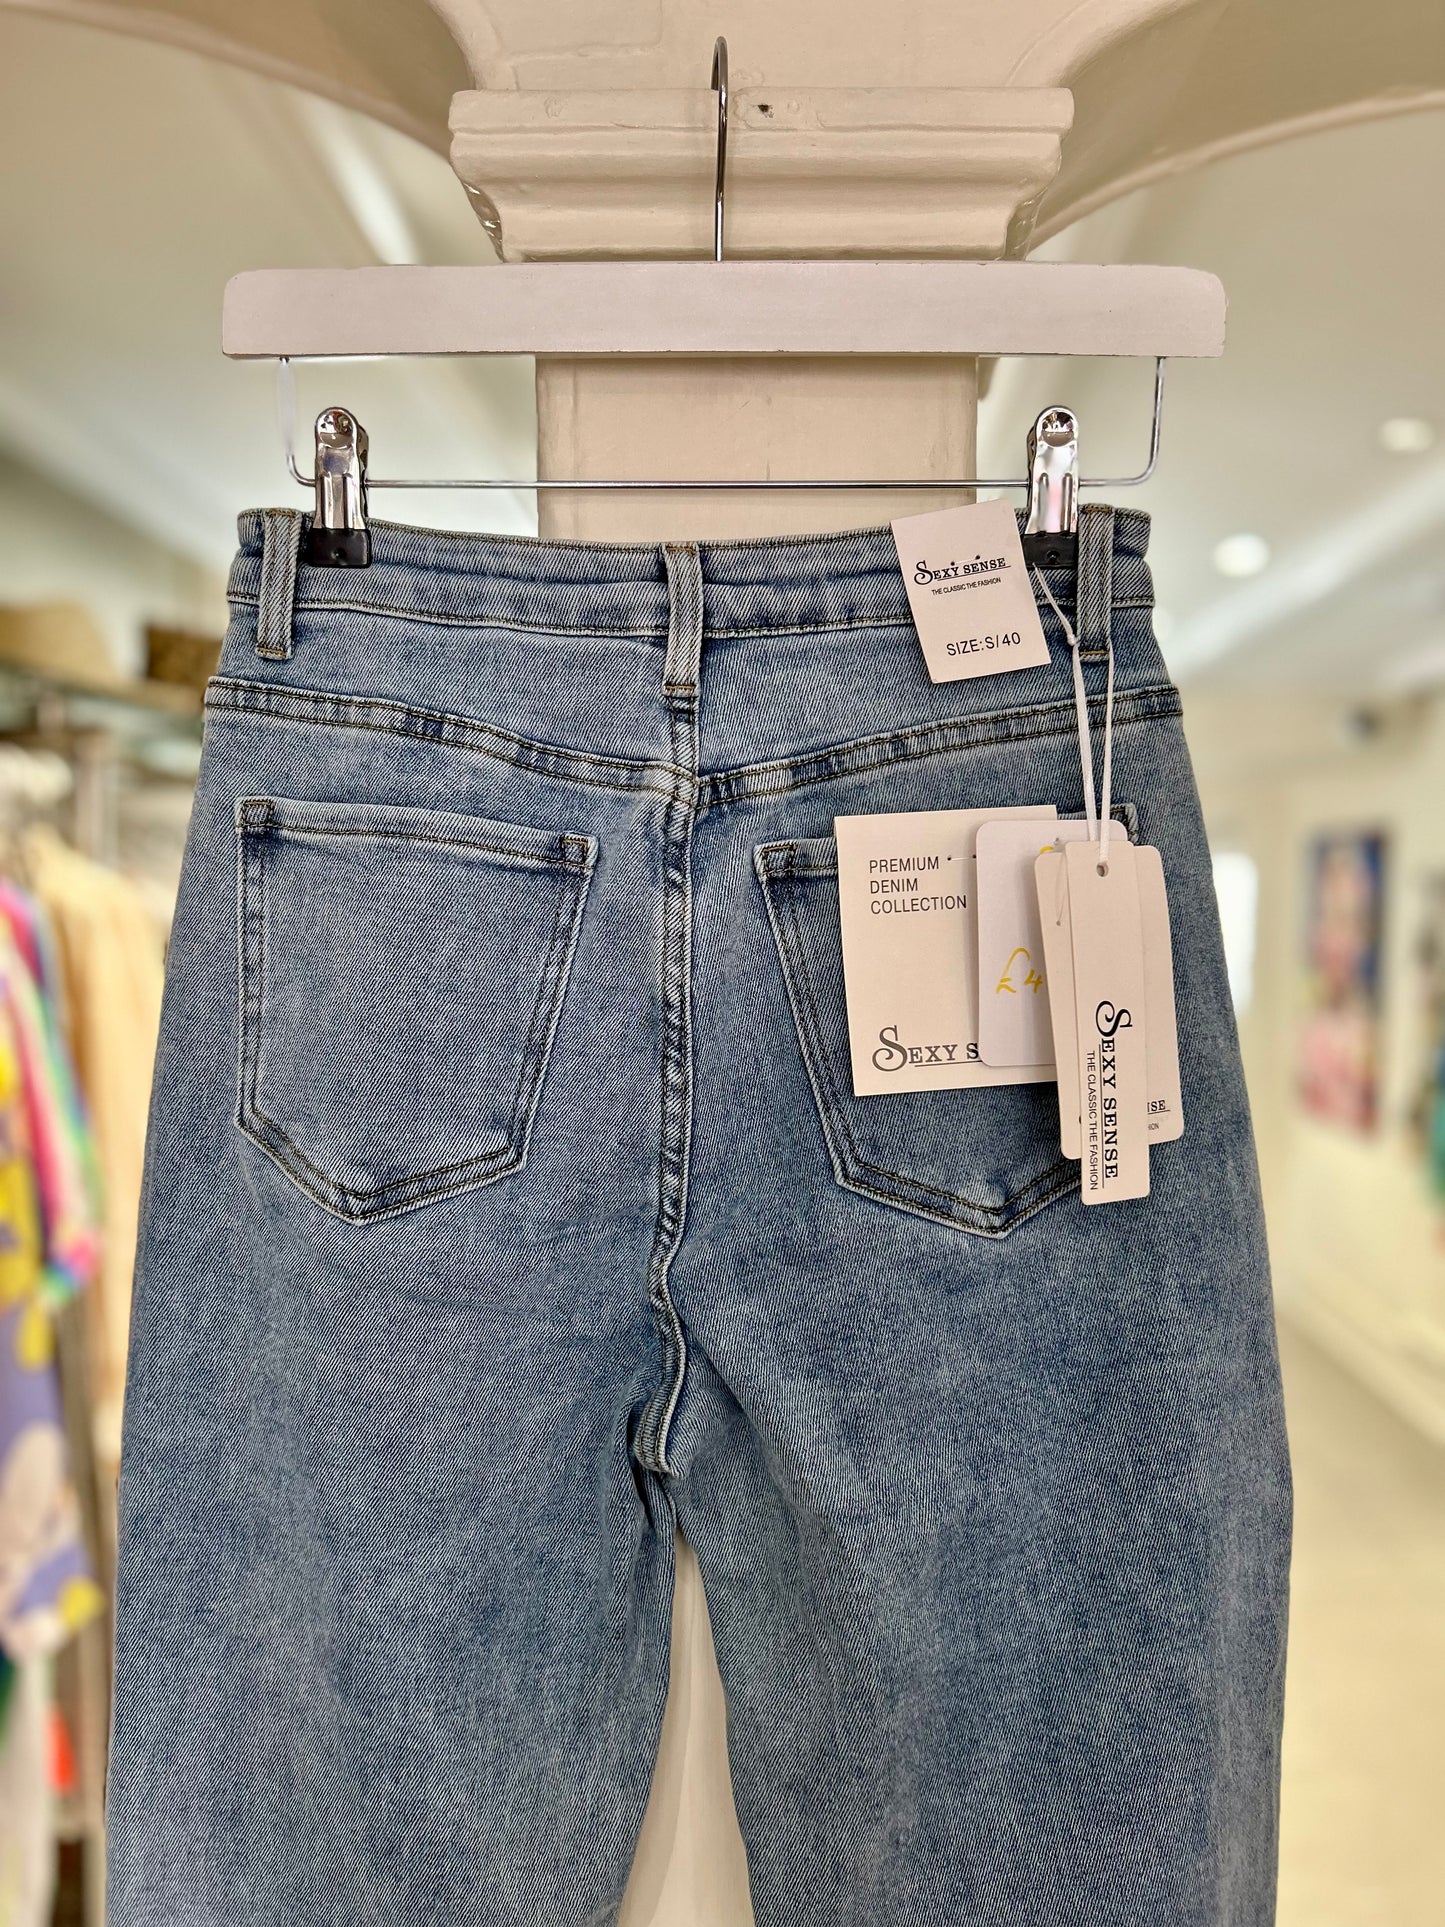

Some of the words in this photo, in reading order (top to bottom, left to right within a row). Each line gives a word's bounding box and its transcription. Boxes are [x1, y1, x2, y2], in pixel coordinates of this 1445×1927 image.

[914, 560, 959, 586] SEXY
[963, 557, 1006, 575] SENSE
[931, 587, 943, 596] THE
[943, 583, 967, 593] CLASSIC
[967, 581, 979, 590] THE
[978, 577, 1001, 587] FASHION
[946, 631, 1021, 656] SIZE:S/40
[869, 856, 940, 874] PREMIUM
[870, 877, 919, 894] DENIM
[870, 895, 968, 915] COLLECTION
[872, 1024, 958, 1072] SEXY
[1095, 1000, 1133, 1089] SEXY
[1086, 1050, 1096, 1072] THE
[1087, 1073, 1098, 1119] CLASSIC
[1089, 1122, 1098, 1142] THE
[1103, 1097, 1119, 1179] SENSE
[1089, 1144, 1099, 1191] FASHION
